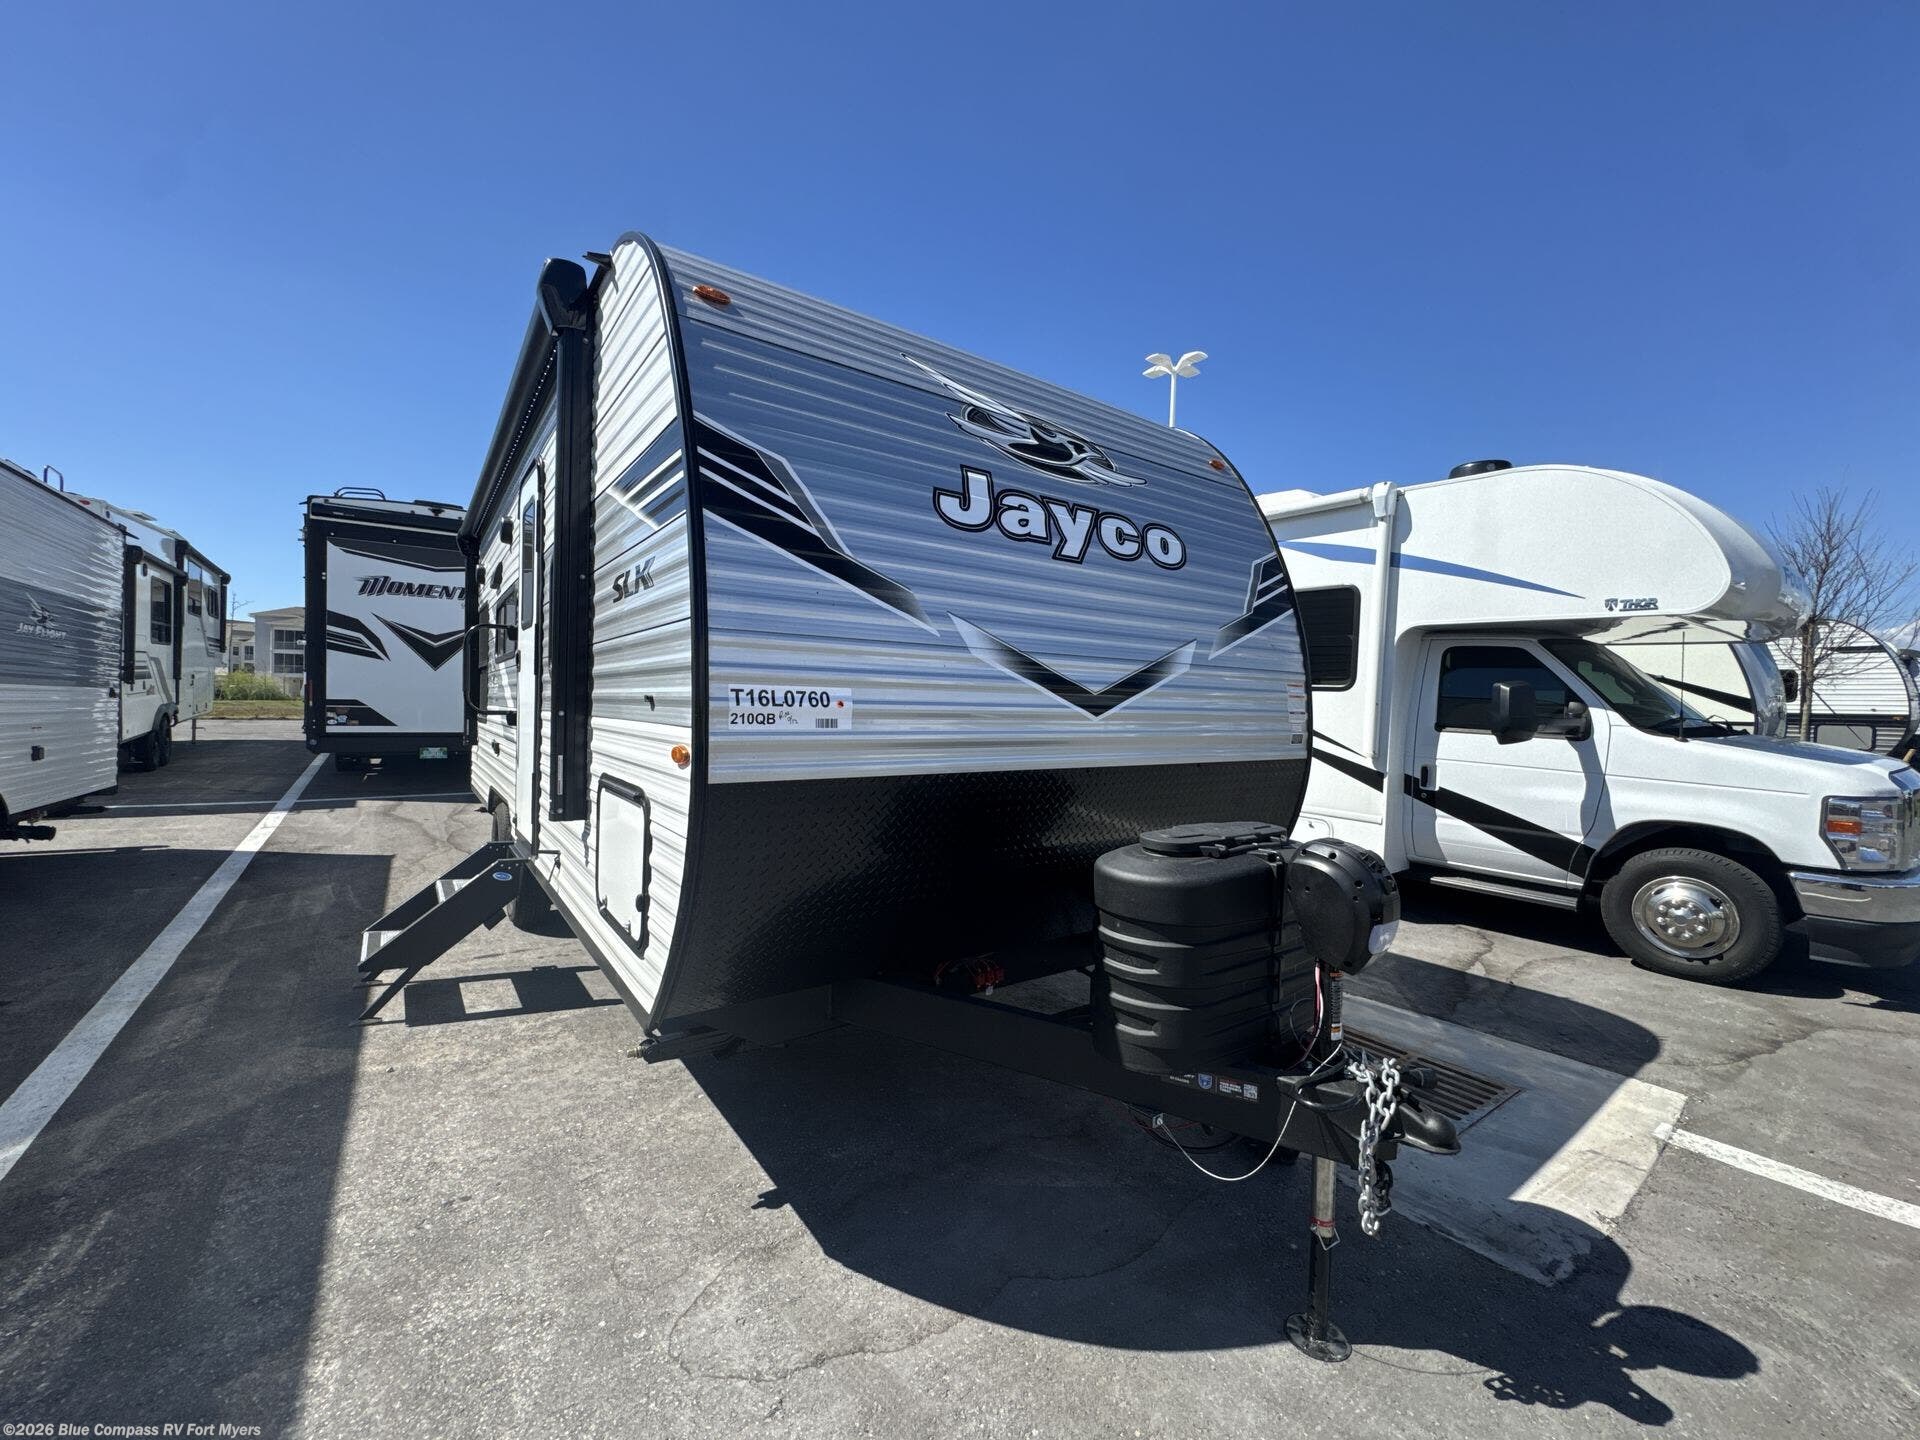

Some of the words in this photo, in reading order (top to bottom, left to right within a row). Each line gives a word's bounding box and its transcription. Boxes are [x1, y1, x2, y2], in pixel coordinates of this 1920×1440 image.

[933, 464, 1186, 570] Jayco
[612, 556, 655, 603] SLK
[1619, 598, 1659, 611] THOR
[16, 622, 34, 636] JAY
[730, 688, 831, 708] T16L0760
[730, 712, 776, 725] 210QB
